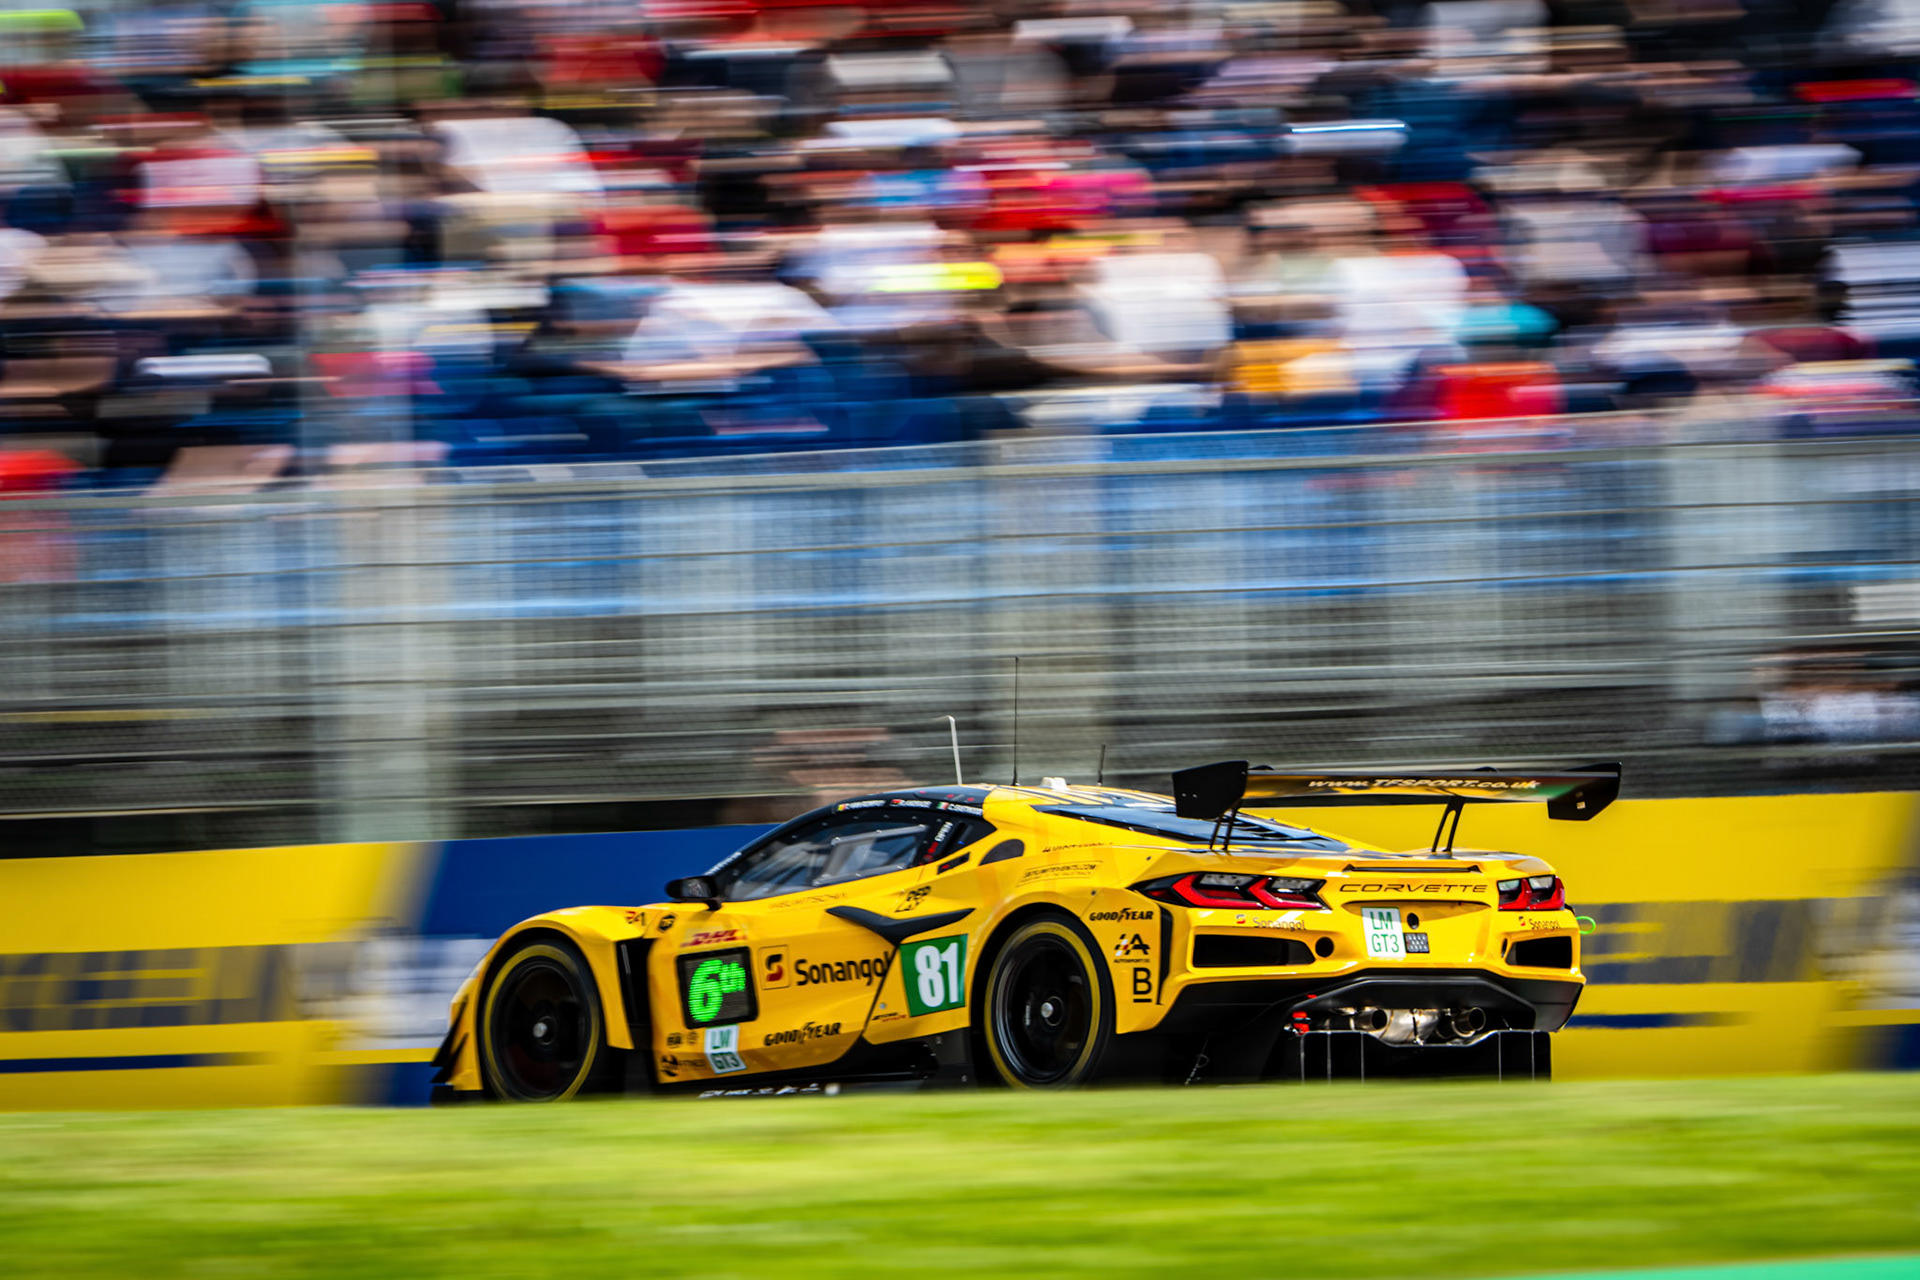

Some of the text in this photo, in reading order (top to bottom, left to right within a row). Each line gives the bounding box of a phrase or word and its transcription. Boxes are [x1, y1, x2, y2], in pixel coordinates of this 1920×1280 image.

[1308, 779, 1540, 789] www.TFSPORT.co.uk
[1340, 884, 1488, 893] CORVETTE
[1089, 907, 1154, 922] GOODYEAR
[1370, 911, 1393, 930] LM
[1252, 917, 1307, 932] Sonangol
[1371, 933, 1400, 953] GT3
[794, 951, 890, 987] Sonangol
[914, 942, 959, 1008] 81
[688, 958, 746, 1022] 6th
[763, 1021, 842, 1047] GOODYEAR
[711, 1051, 741, 1070] GT3
